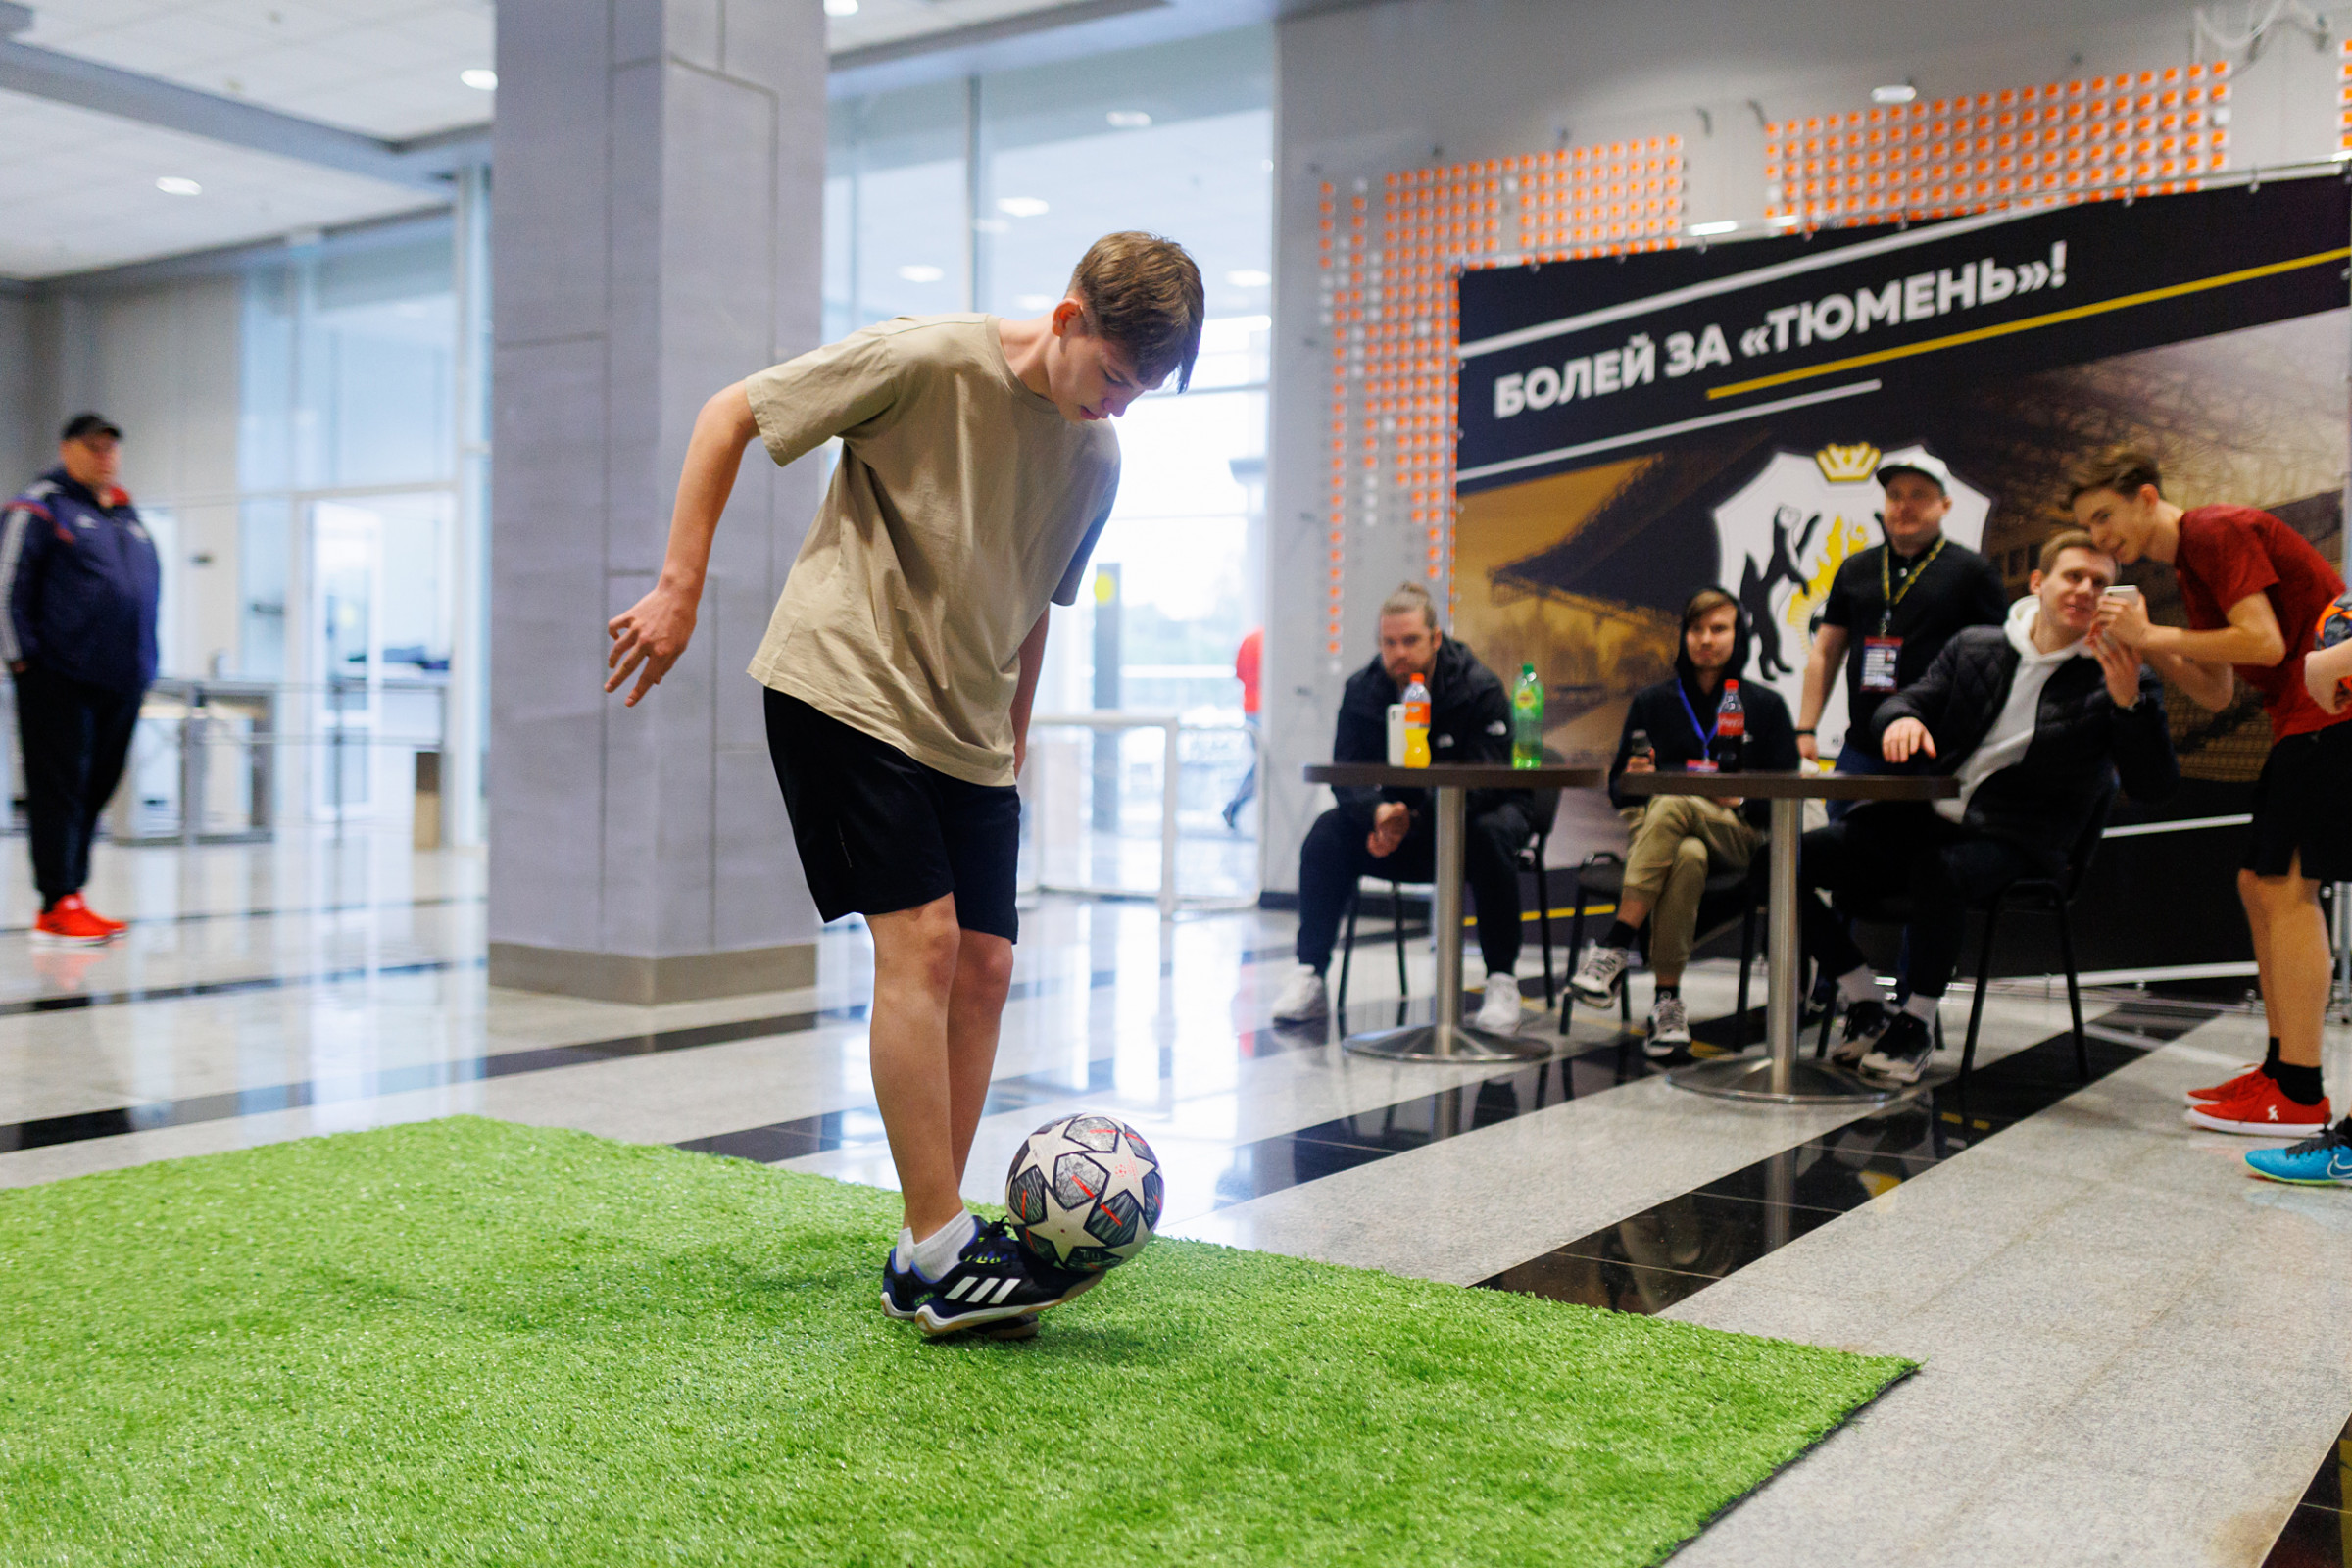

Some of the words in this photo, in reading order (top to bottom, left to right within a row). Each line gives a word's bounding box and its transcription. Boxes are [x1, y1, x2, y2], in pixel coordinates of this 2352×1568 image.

[1494, 332, 1656, 419] БОЛЕЙ
[1664, 323, 1732, 378] ЗА
[1740, 240, 2067, 358] «ТЮМЕНЬ»!
